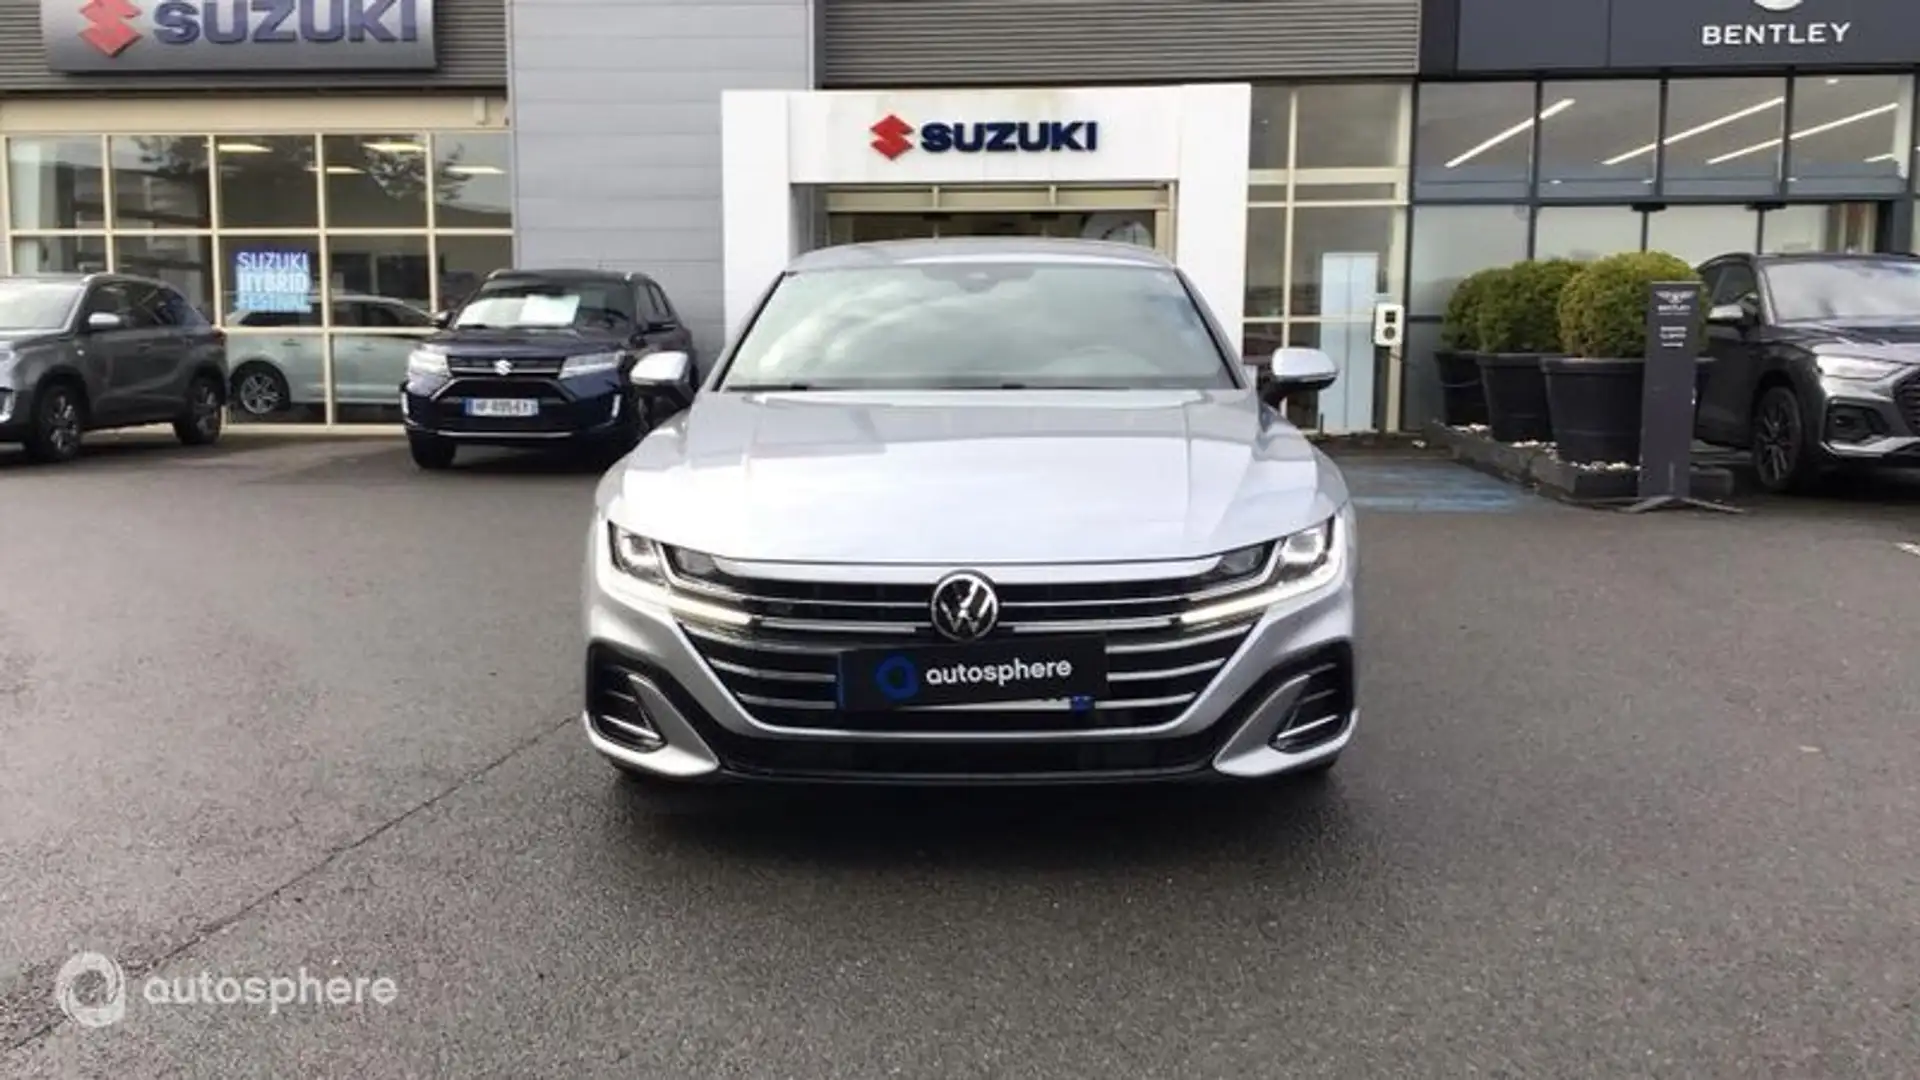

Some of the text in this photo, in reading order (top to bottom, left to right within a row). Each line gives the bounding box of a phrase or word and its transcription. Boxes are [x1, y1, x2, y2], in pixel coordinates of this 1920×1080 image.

[152, 0, 417, 45] SUZUKI
[1702, 22, 1851, 46] BENTLEY
[920, 121, 1098, 153] SUZUKI
[237, 252, 308, 269] SUZUKI
